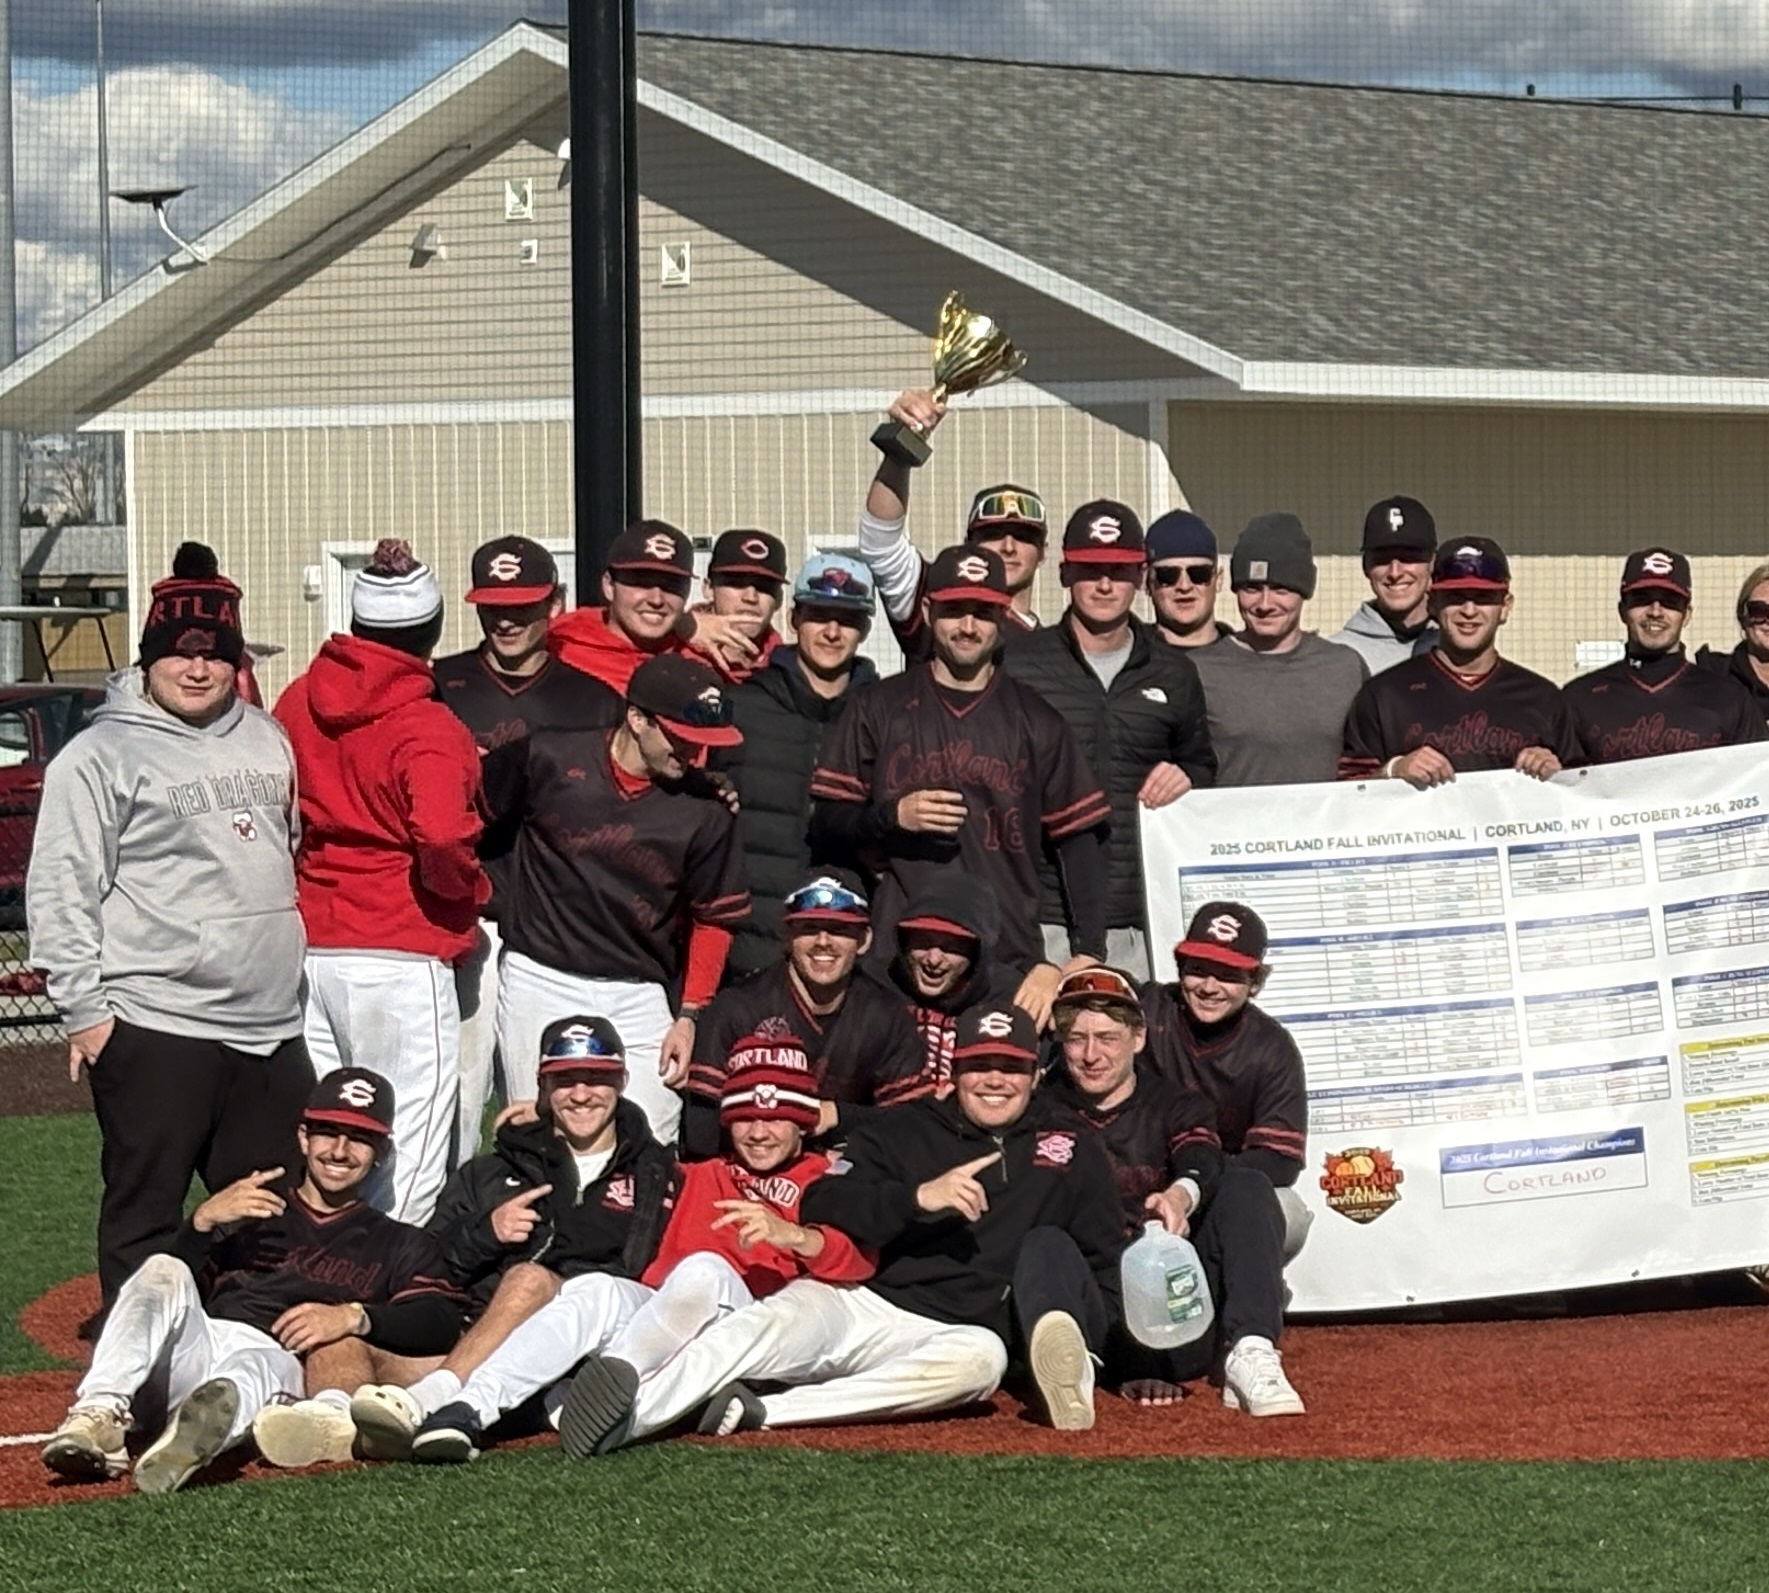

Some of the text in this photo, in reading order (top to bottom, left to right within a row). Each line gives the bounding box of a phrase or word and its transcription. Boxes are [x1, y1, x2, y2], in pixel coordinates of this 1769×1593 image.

[167, 782, 211, 821] RED
[1210, 842, 1242, 857] 2025
[1245, 836, 1324, 855] CORTLAND
[1327, 835, 1363, 850] FALL
[1367, 828, 1467, 847] INVITATIONAL
[1485, 820, 1568, 838] CORTLAND,
[1571, 818, 1591, 831] NY
[1610, 808, 1681, 827] OCTOBER
[1684, 802, 1725, 819] 24-26,
[1729, 795, 1760, 812] 2025
[729, 1048, 808, 1072] CORTLAND
